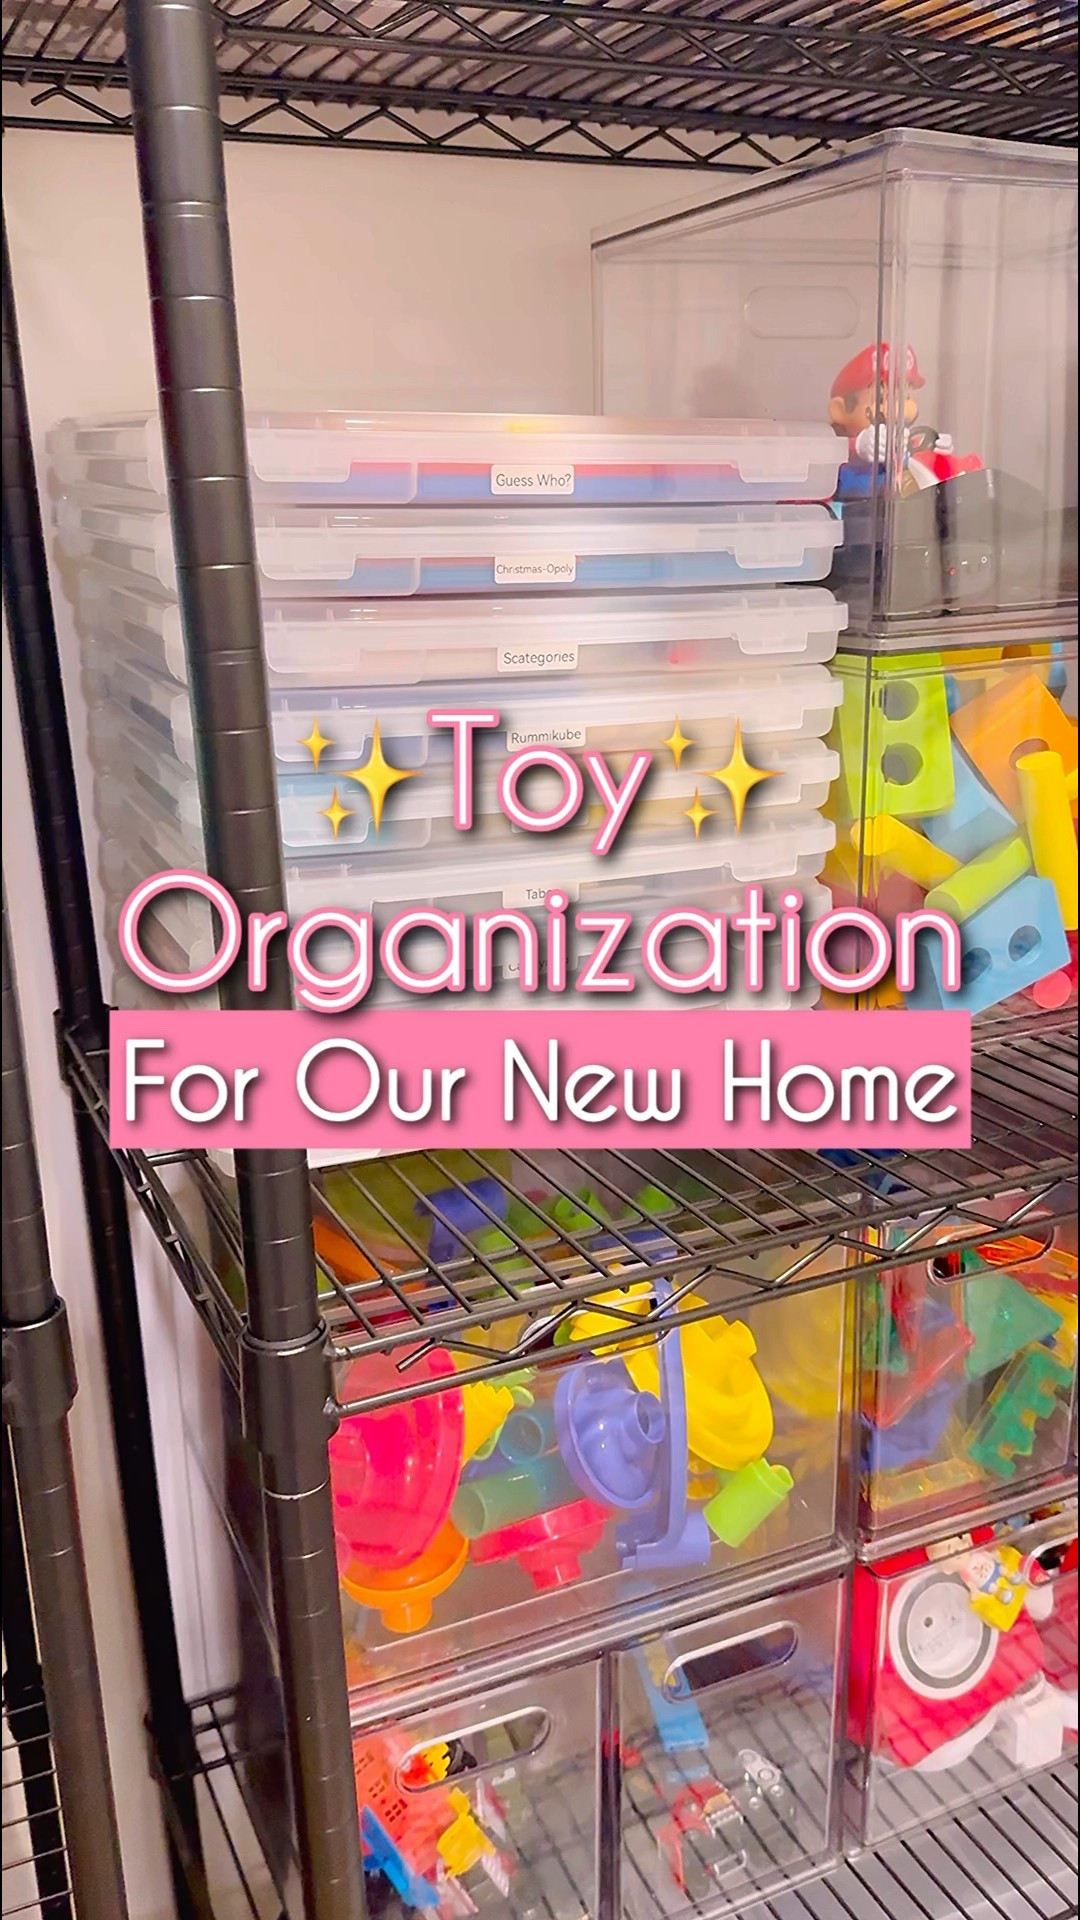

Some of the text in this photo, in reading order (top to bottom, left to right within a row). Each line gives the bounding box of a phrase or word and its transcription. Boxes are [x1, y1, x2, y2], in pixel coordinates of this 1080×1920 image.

[495, 473, 572, 487] Guess Who?
[495, 563, 574, 575] Christmas-Opoly
[503, 651, 575, 667] Scategories
[511, 729, 582, 744] Rummikube
